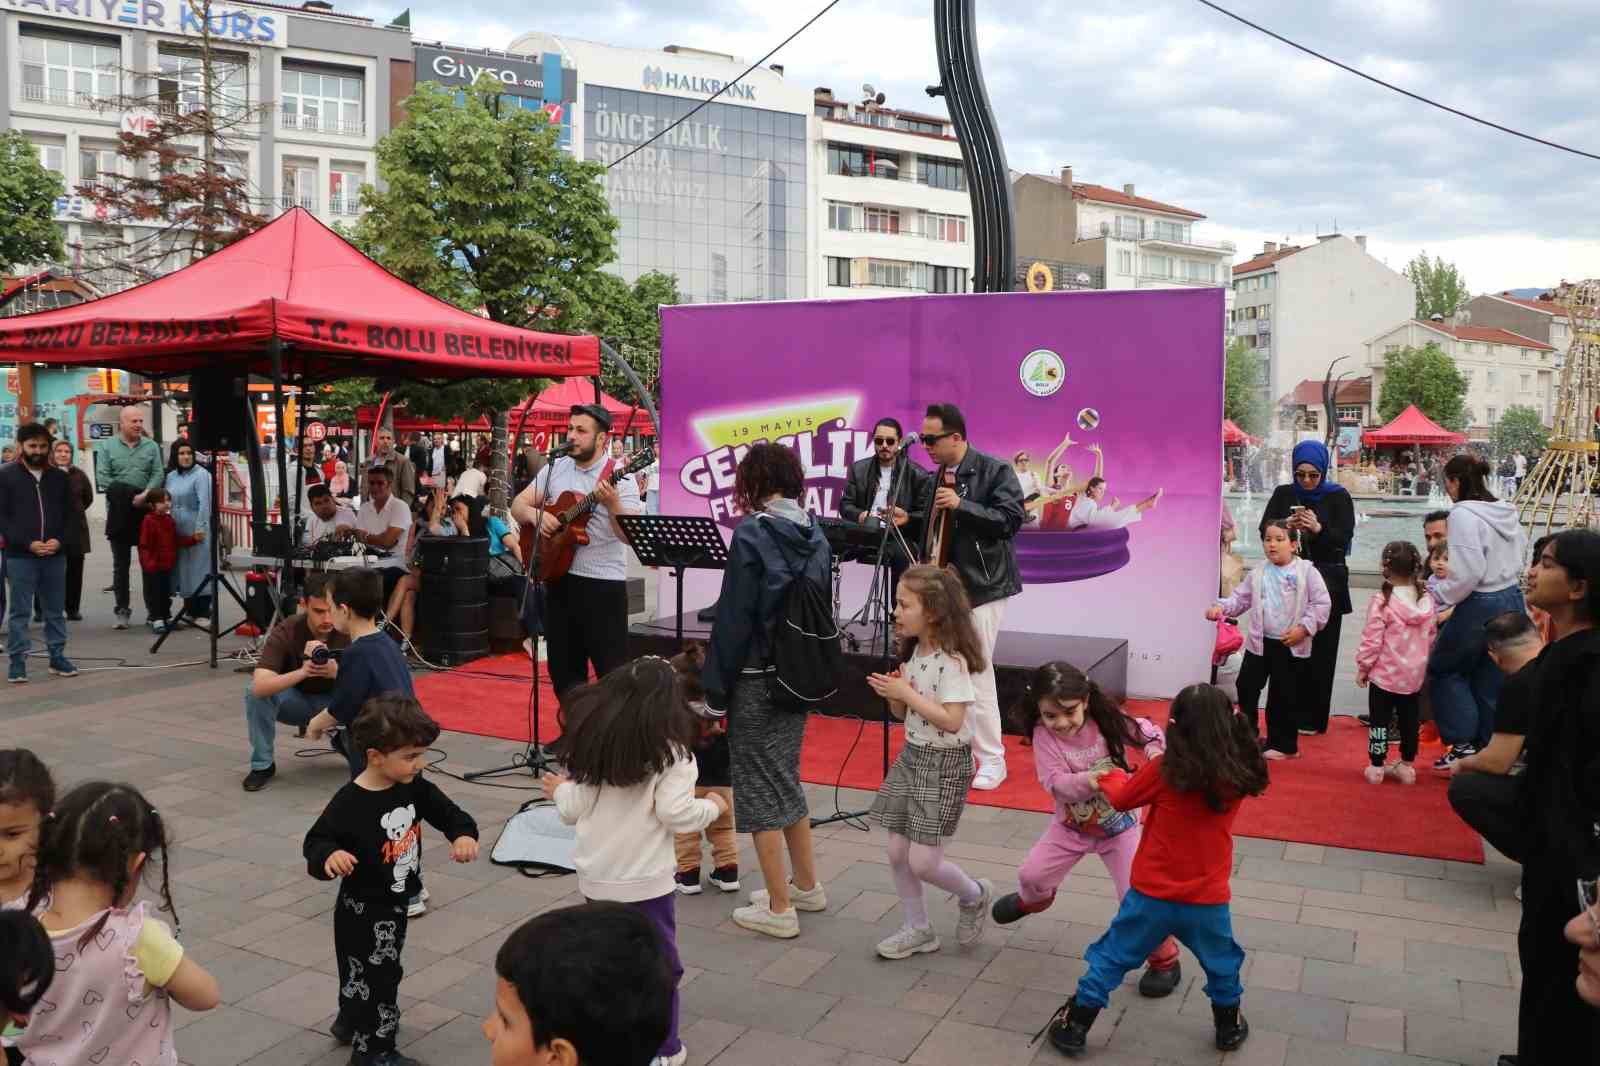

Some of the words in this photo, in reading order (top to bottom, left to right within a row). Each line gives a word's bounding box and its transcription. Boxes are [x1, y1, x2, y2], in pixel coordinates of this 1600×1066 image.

[180, 4, 275, 41] KURS
[665, 71, 756, 101] HALKBANK
[595, 102, 656, 140] ÖNCE
[305, 318, 357, 346] T.C.
[367, 325, 436, 354] BOLU
[444, 334, 573, 366] BELEDİYESİ
[732, 425, 749, 437] 19
